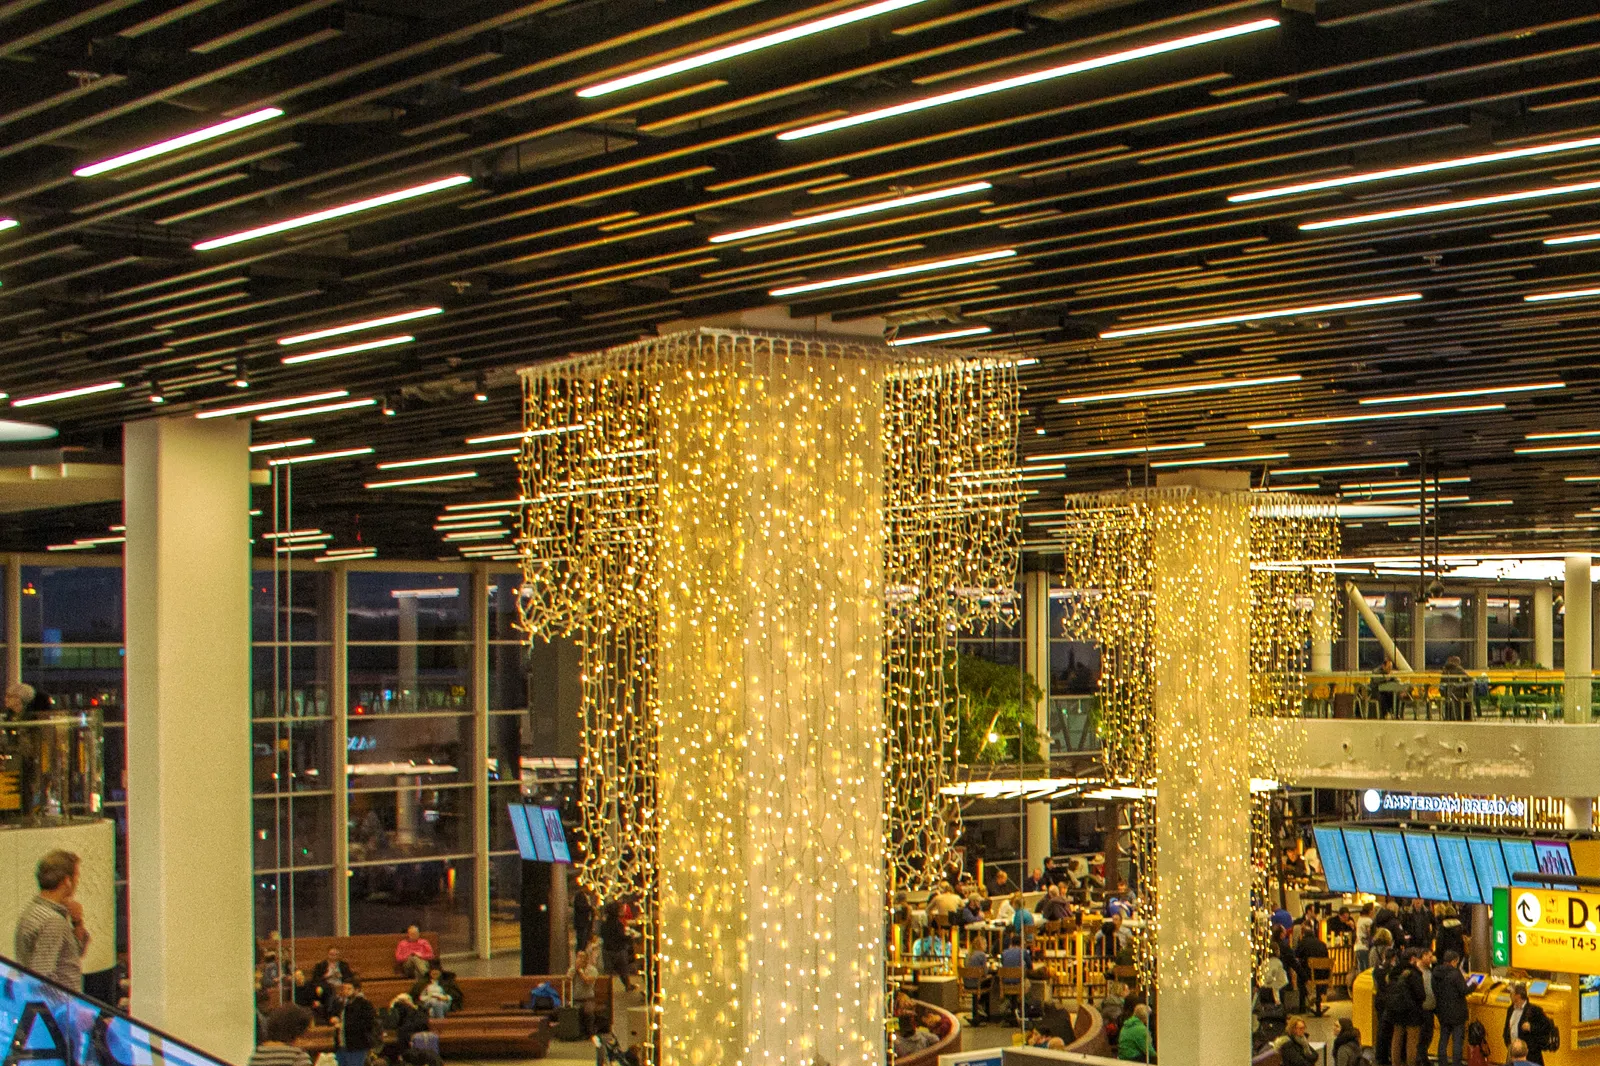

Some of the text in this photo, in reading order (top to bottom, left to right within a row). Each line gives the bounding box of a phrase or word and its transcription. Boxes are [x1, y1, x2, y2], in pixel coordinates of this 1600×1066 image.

[1384, 795, 1460, 811] AMSTERDAM
[1462, 798, 1506, 815] BREAD
[1545, 916, 1565, 925] Gates
[1568, 897, 1589, 928] D
[1540, 936, 1597, 951] Transfer T4-5
